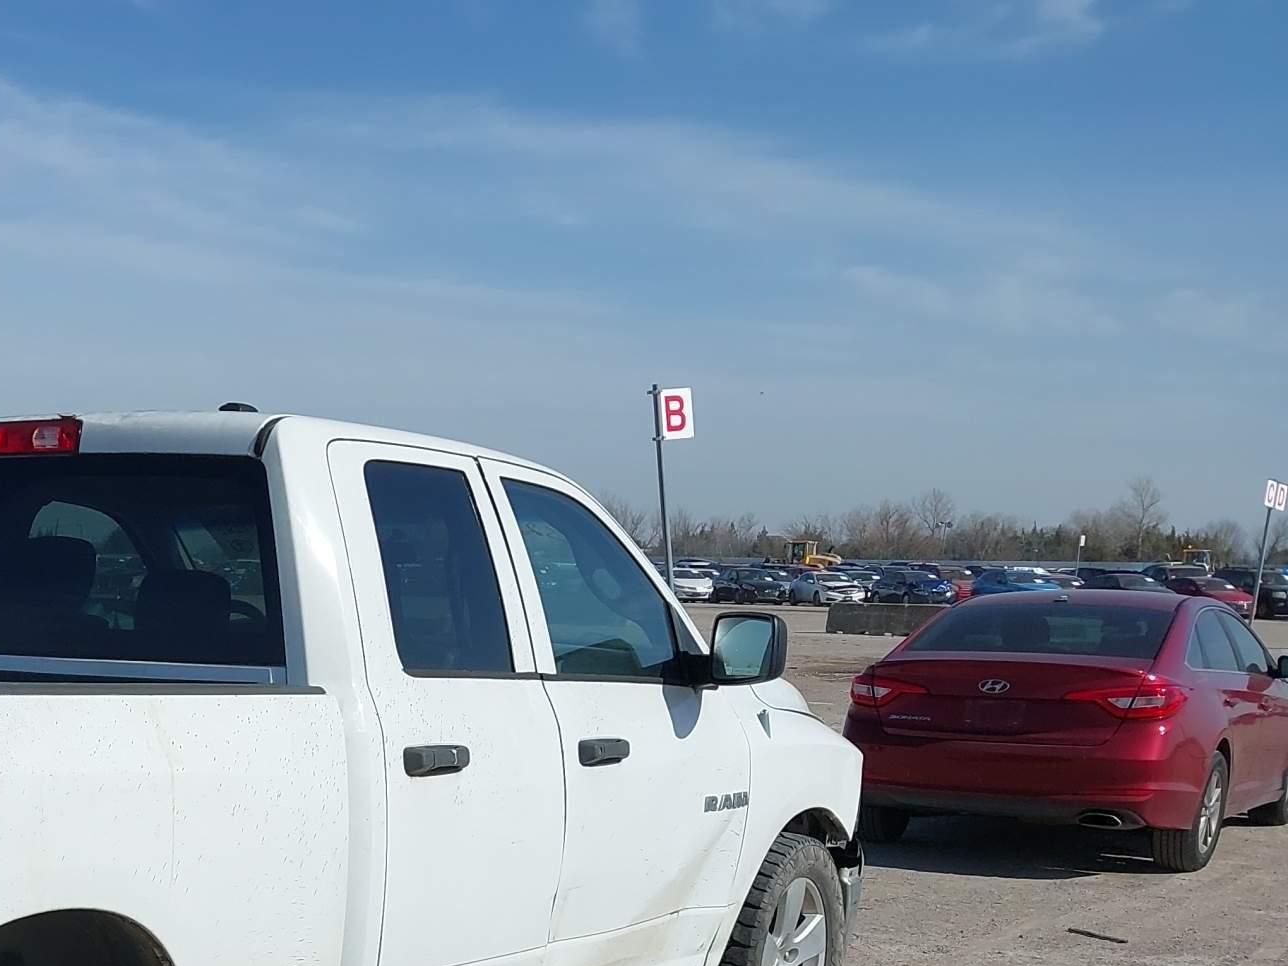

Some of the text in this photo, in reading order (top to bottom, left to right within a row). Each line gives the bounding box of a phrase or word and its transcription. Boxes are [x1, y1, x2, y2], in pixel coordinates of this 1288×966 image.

[664, 395, 686, 432] B
[1268, 484, 1275, 503] C
[703, 791, 749, 812] RAM
